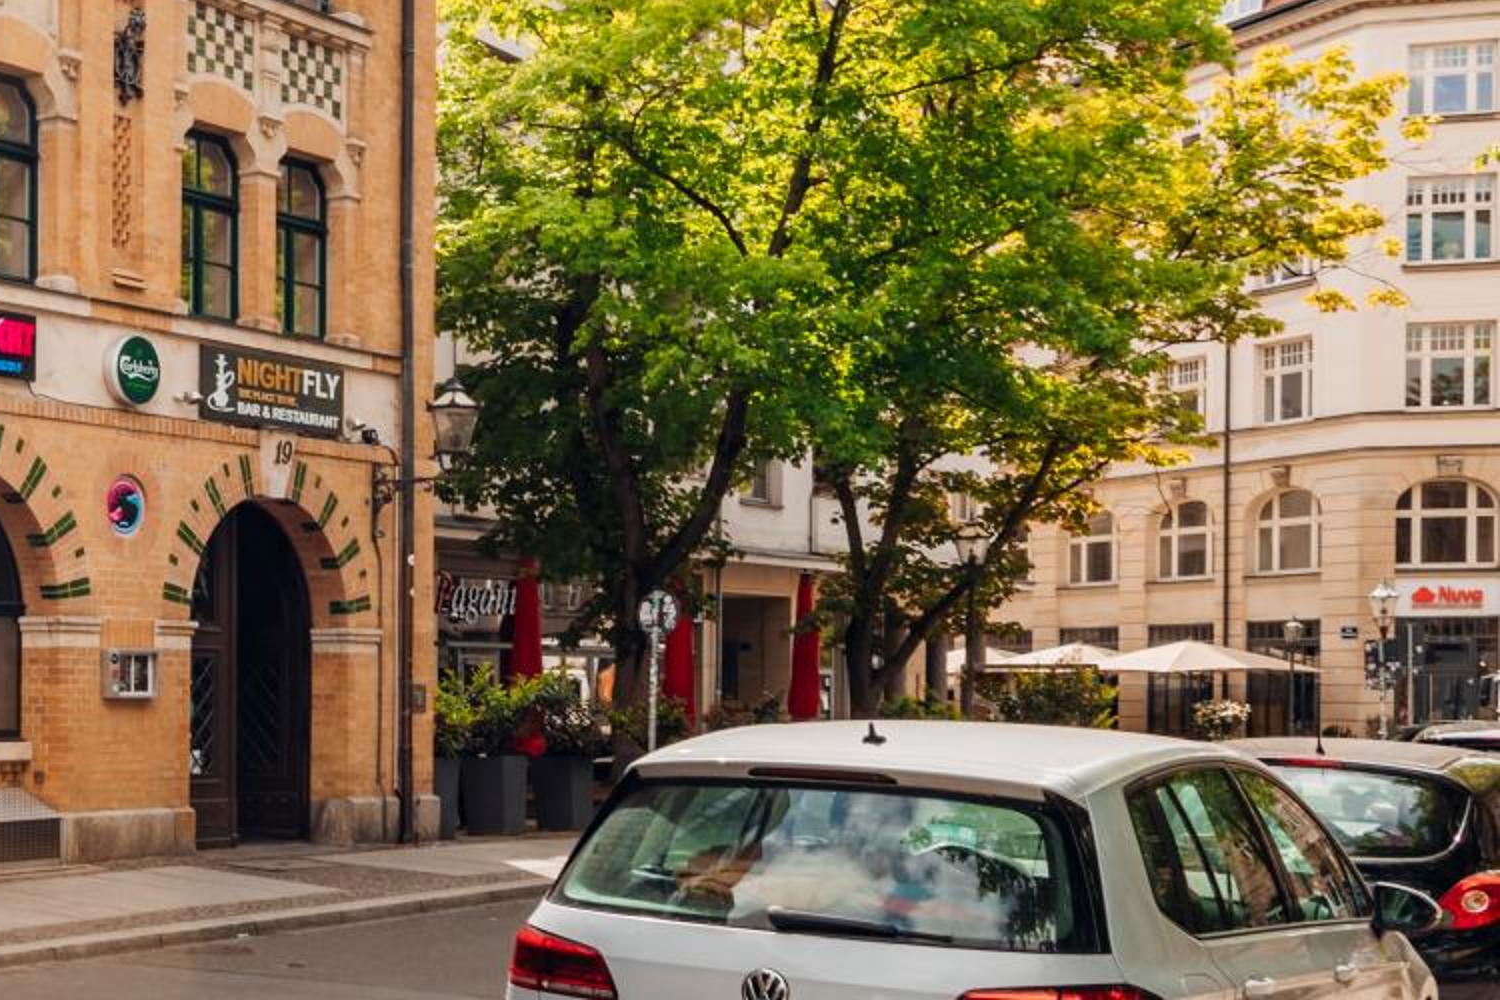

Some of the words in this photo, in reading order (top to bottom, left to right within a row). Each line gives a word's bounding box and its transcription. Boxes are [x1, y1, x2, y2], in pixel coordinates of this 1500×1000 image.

[236, 357, 340, 400] NIGHTFLY
[237, 401, 261, 417] BAR
[262, 405, 271, 419] &
[272, 407, 340, 430] RESTAURANT
[274, 440, 293, 465] 19
